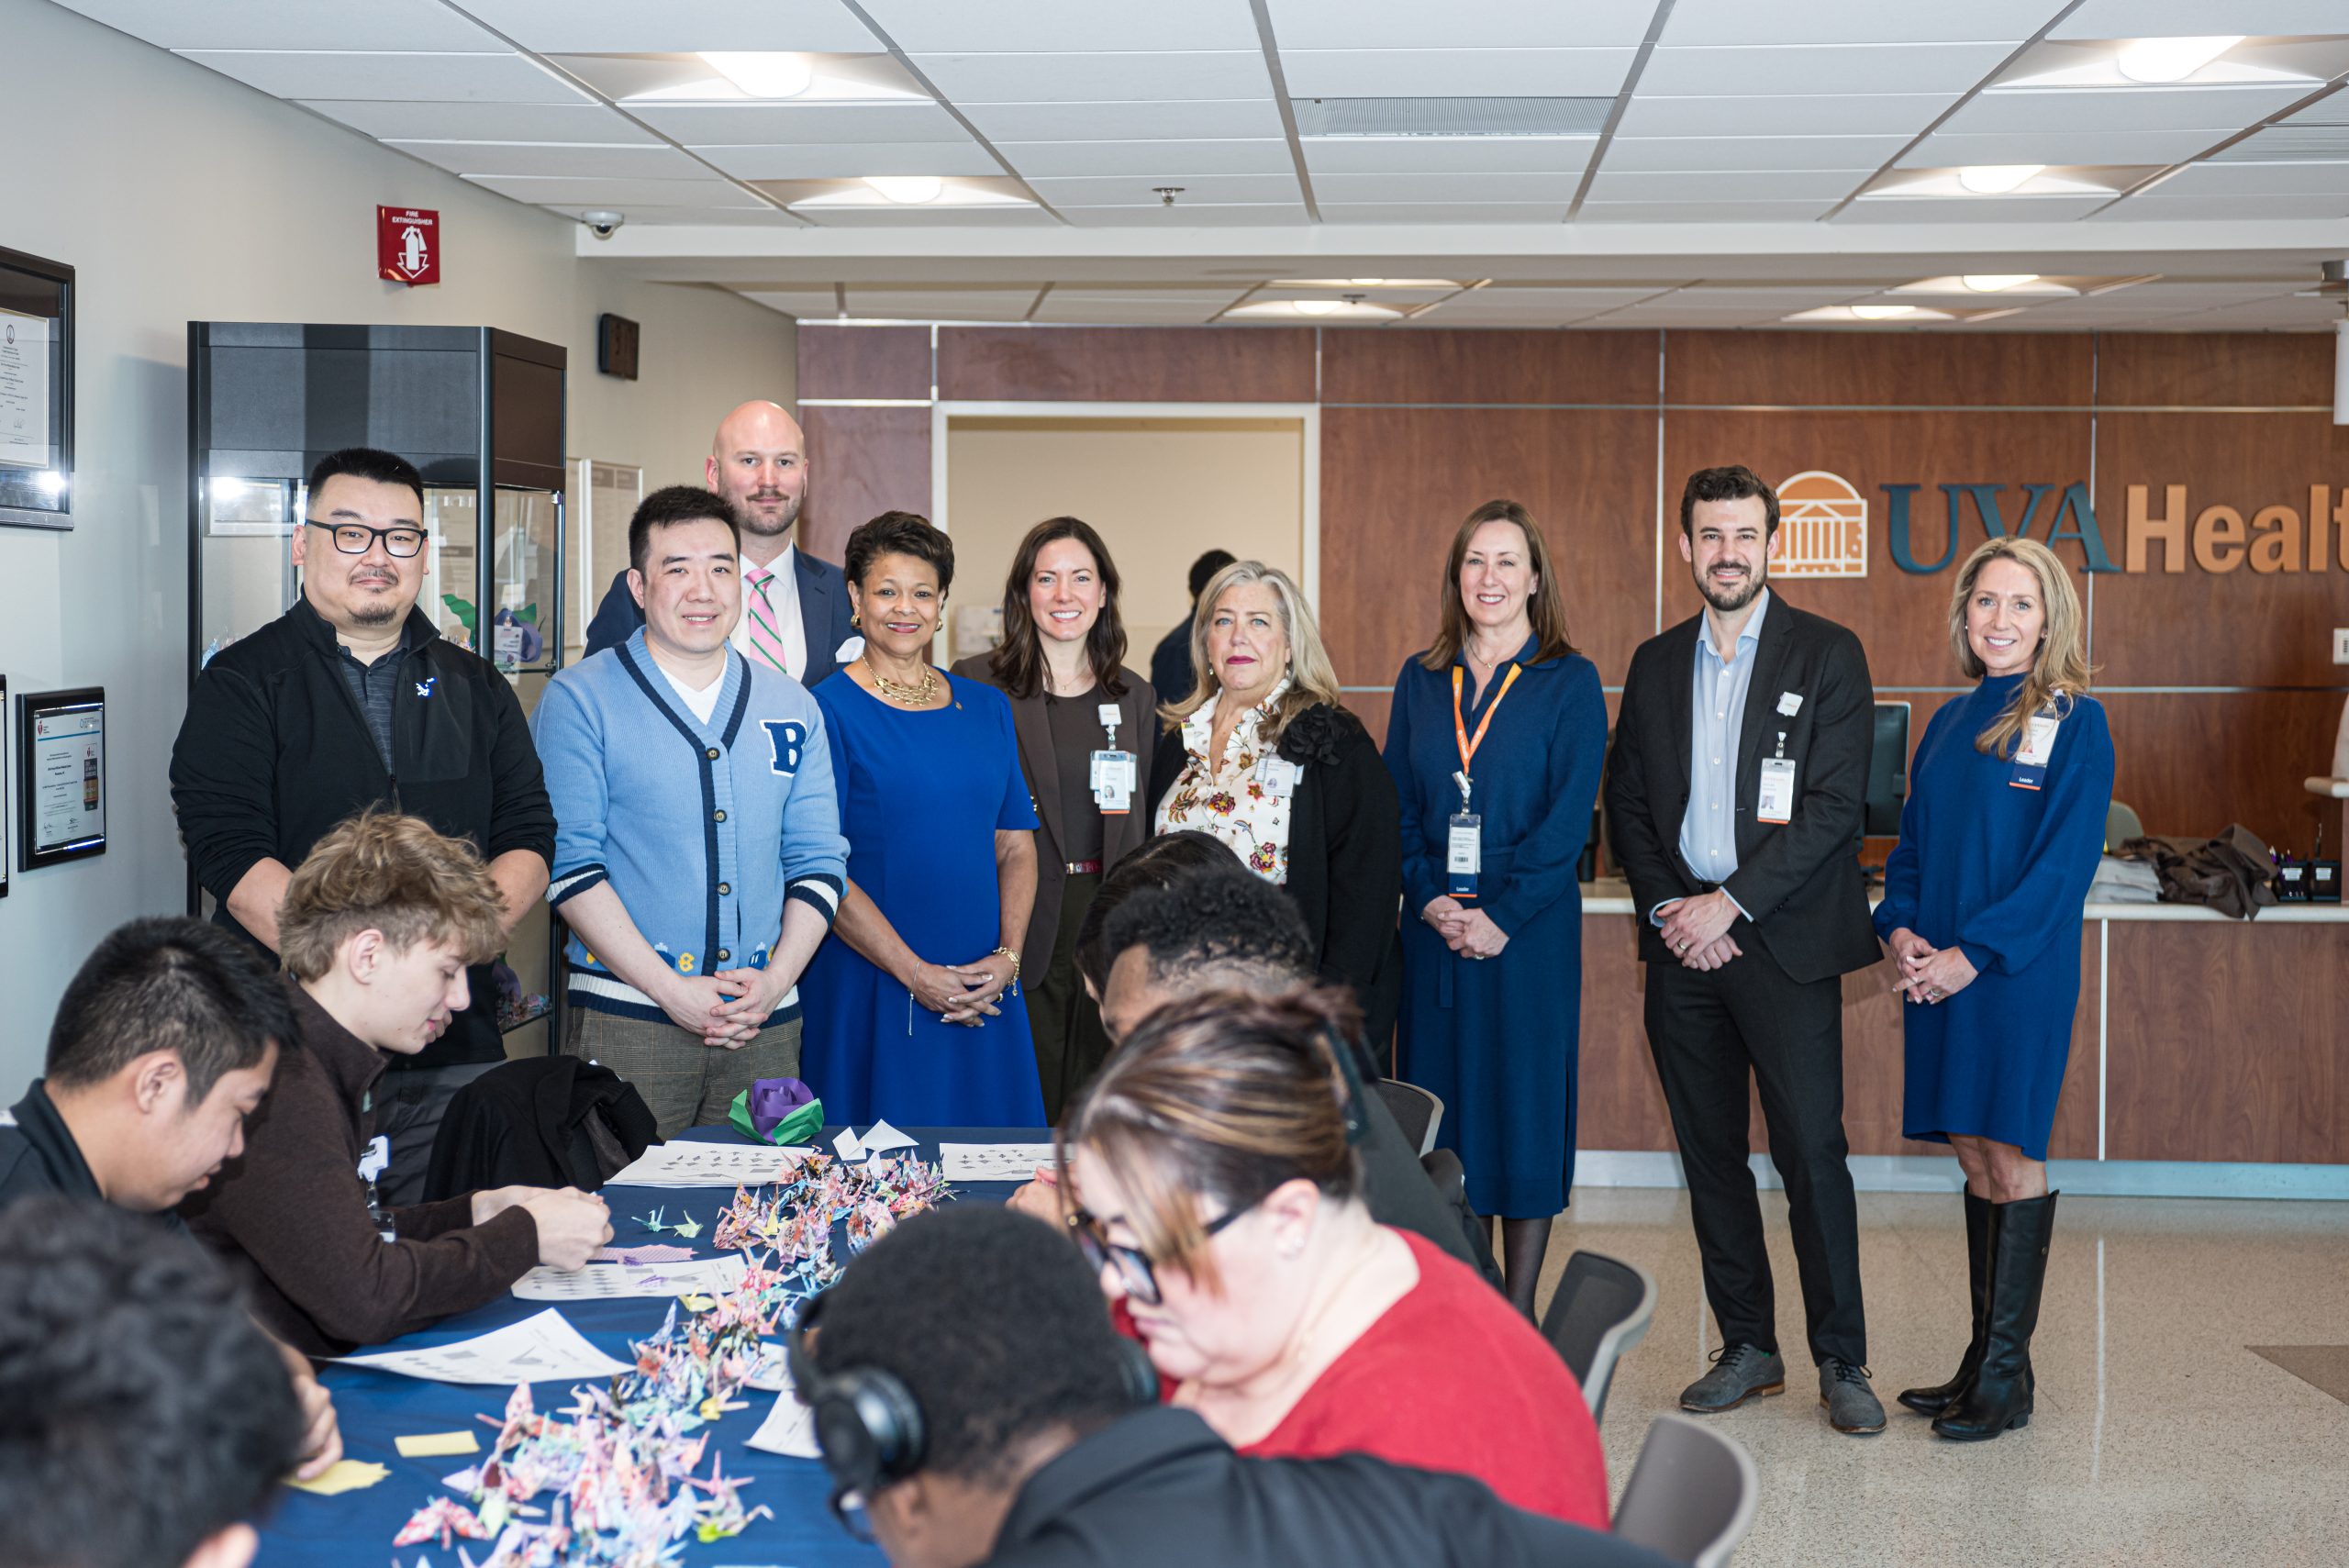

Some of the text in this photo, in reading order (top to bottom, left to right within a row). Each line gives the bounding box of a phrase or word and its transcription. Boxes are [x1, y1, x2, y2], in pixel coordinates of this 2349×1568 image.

[392, 217, 433, 226] EXTINGUISHER
[1879, 481, 2121, 574] UVA
[760, 718, 807, 777] B
[2019, 776, 2033, 784] Leader
